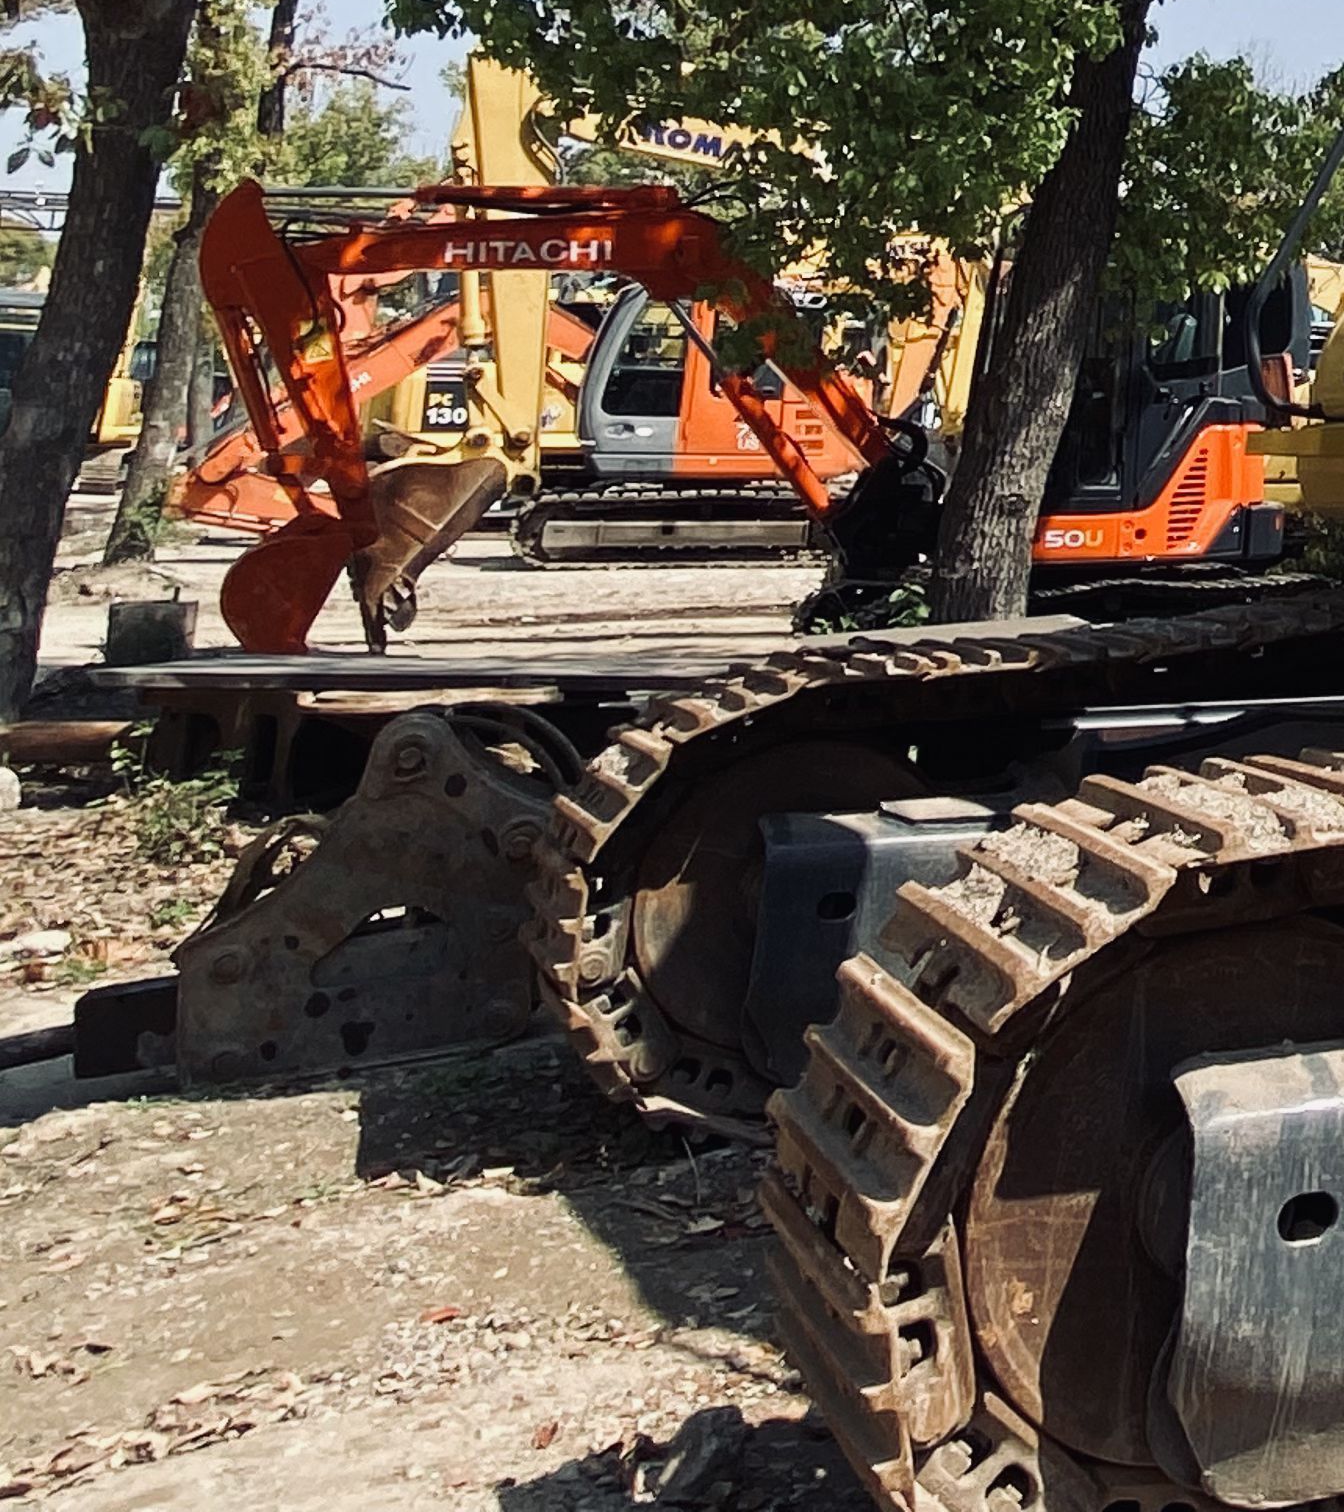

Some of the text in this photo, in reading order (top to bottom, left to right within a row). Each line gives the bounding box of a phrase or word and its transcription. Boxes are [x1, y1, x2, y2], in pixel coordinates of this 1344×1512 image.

[444, 240, 613, 263] HITACHI
[428, 393, 454, 407] PC
[426, 407, 468, 425] 130
[1044, 529, 1104, 548] 50U
